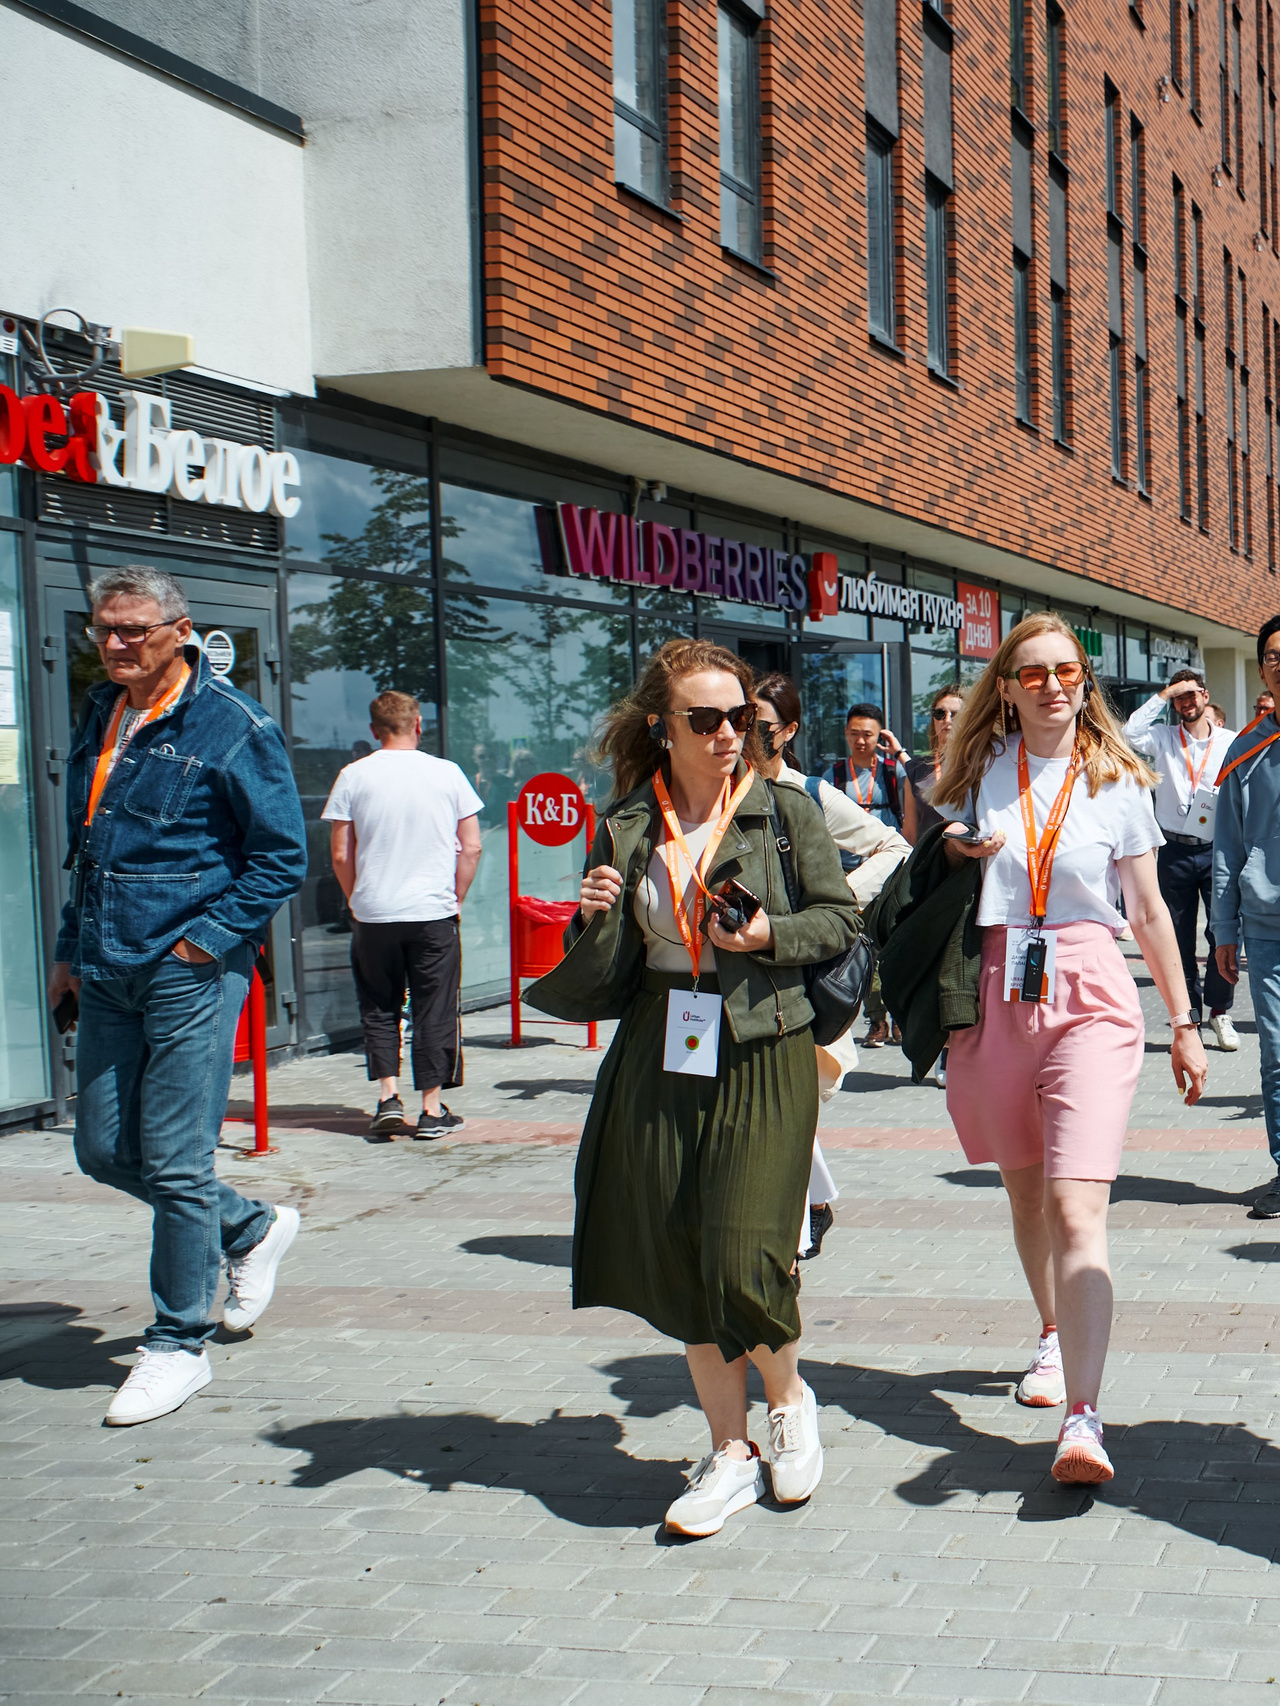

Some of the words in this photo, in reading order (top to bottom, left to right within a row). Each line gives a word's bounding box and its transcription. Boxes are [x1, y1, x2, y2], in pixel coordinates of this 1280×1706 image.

[119, 390, 302, 519] Белое
[556, 501, 808, 612] WILDBERRIES
[840, 570, 920, 621] любимая
[922, 593, 965, 634] кухня
[966, 593, 978, 616] ЗА
[979, 590, 992, 618] 10
[965, 621, 992, 650] ДНЕЙ
[525, 792, 579, 827] К&Б
